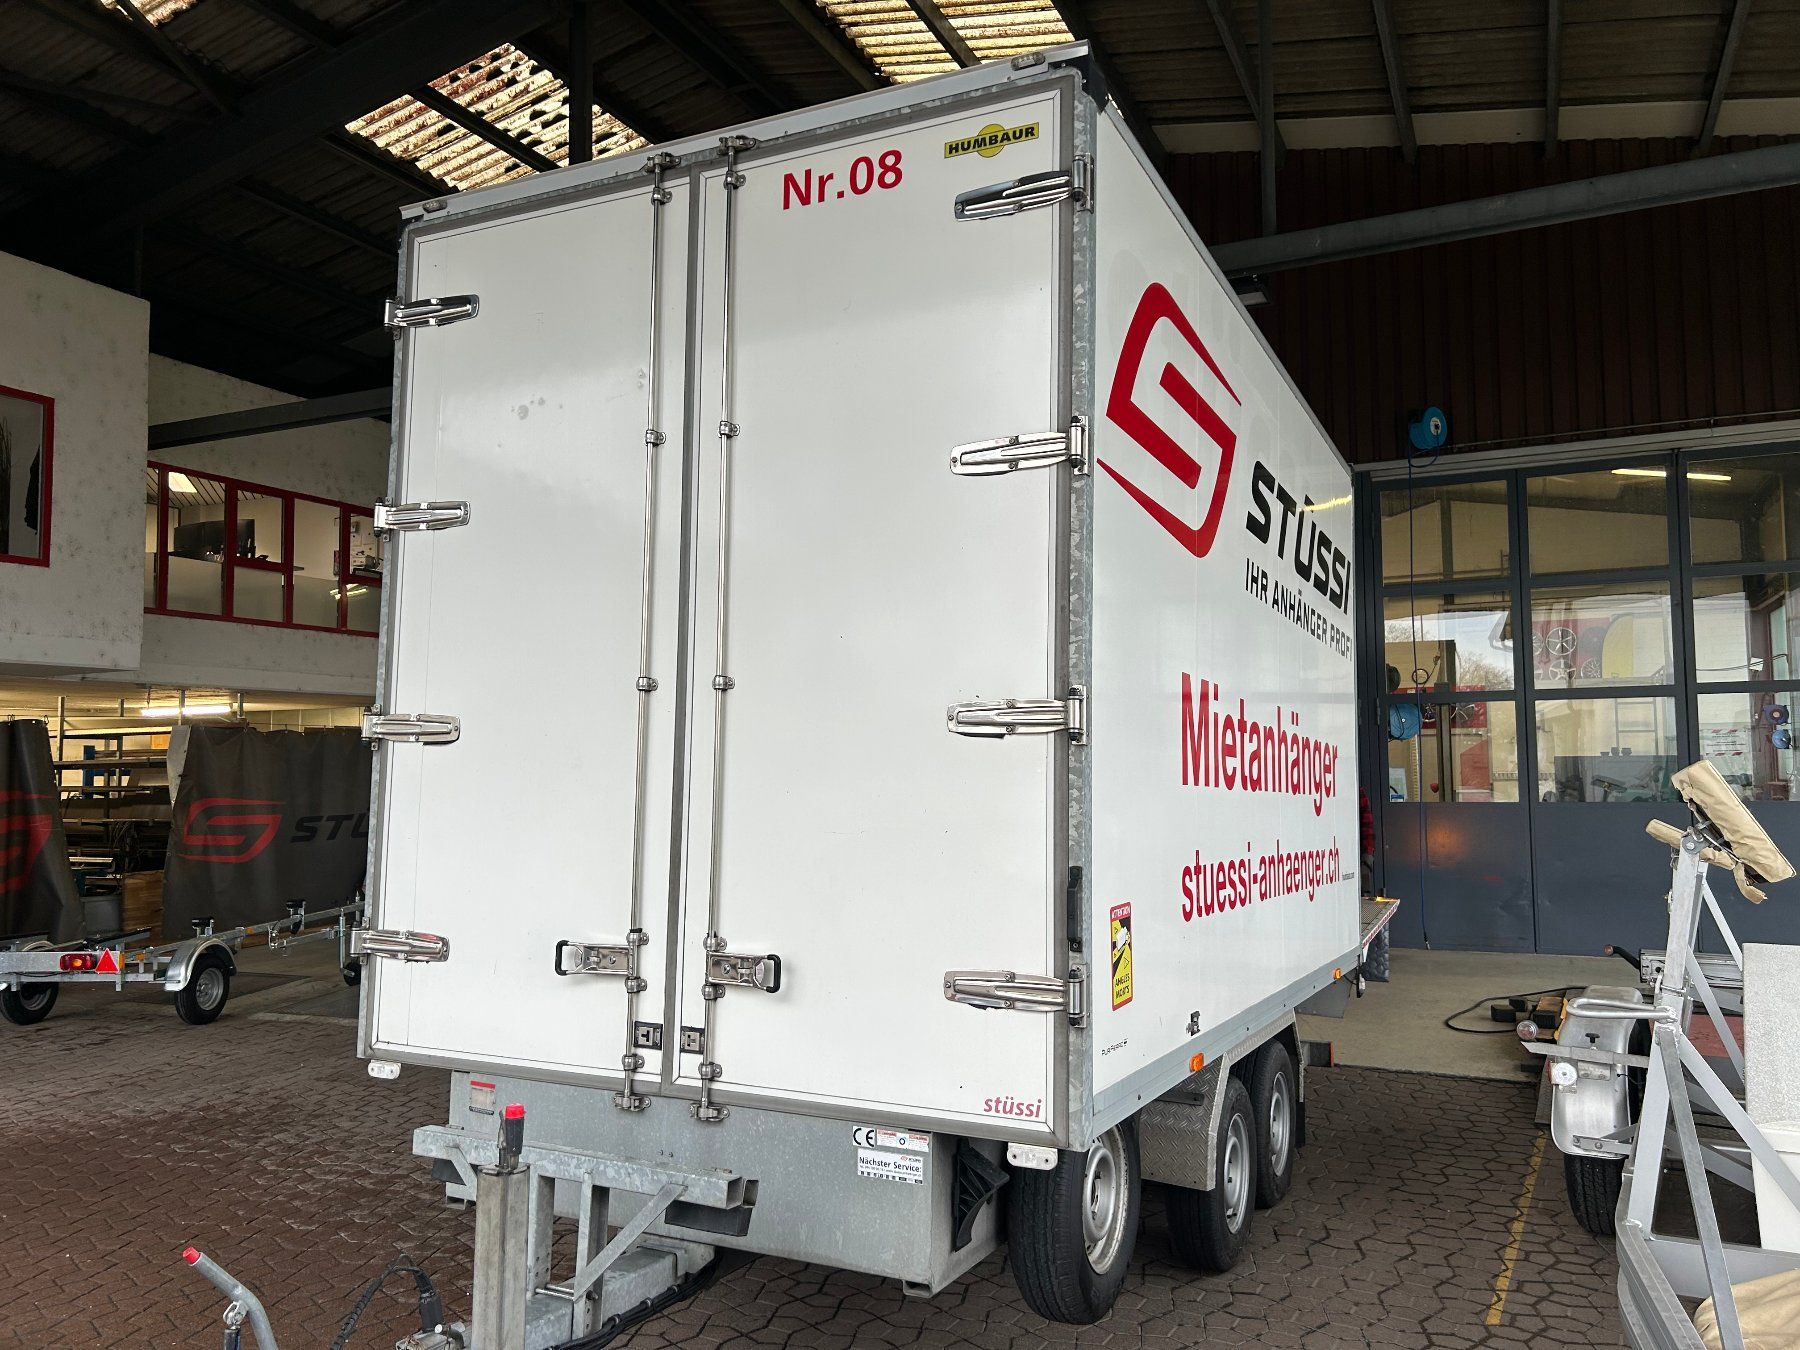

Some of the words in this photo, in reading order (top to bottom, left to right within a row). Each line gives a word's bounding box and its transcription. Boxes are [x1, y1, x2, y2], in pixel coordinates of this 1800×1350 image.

[948, 126, 1036, 155] HUMBAUR
[782, 149, 903, 210] Nr.08
[1246, 460, 1351, 616] STÜSSI
[1245, 557, 1269, 605] IHR
[1271, 588, 1328, 646] ANHÄNGER
[1329, 622, 1353, 662] PROFI
[1181, 671, 1339, 817] Mietanhänger
[1181, 835, 1340, 922] stuessi-anhaenger.ch
[983, 1095, 1042, 1118] stüssi
[859, 1156, 892, 1169] Nächster
